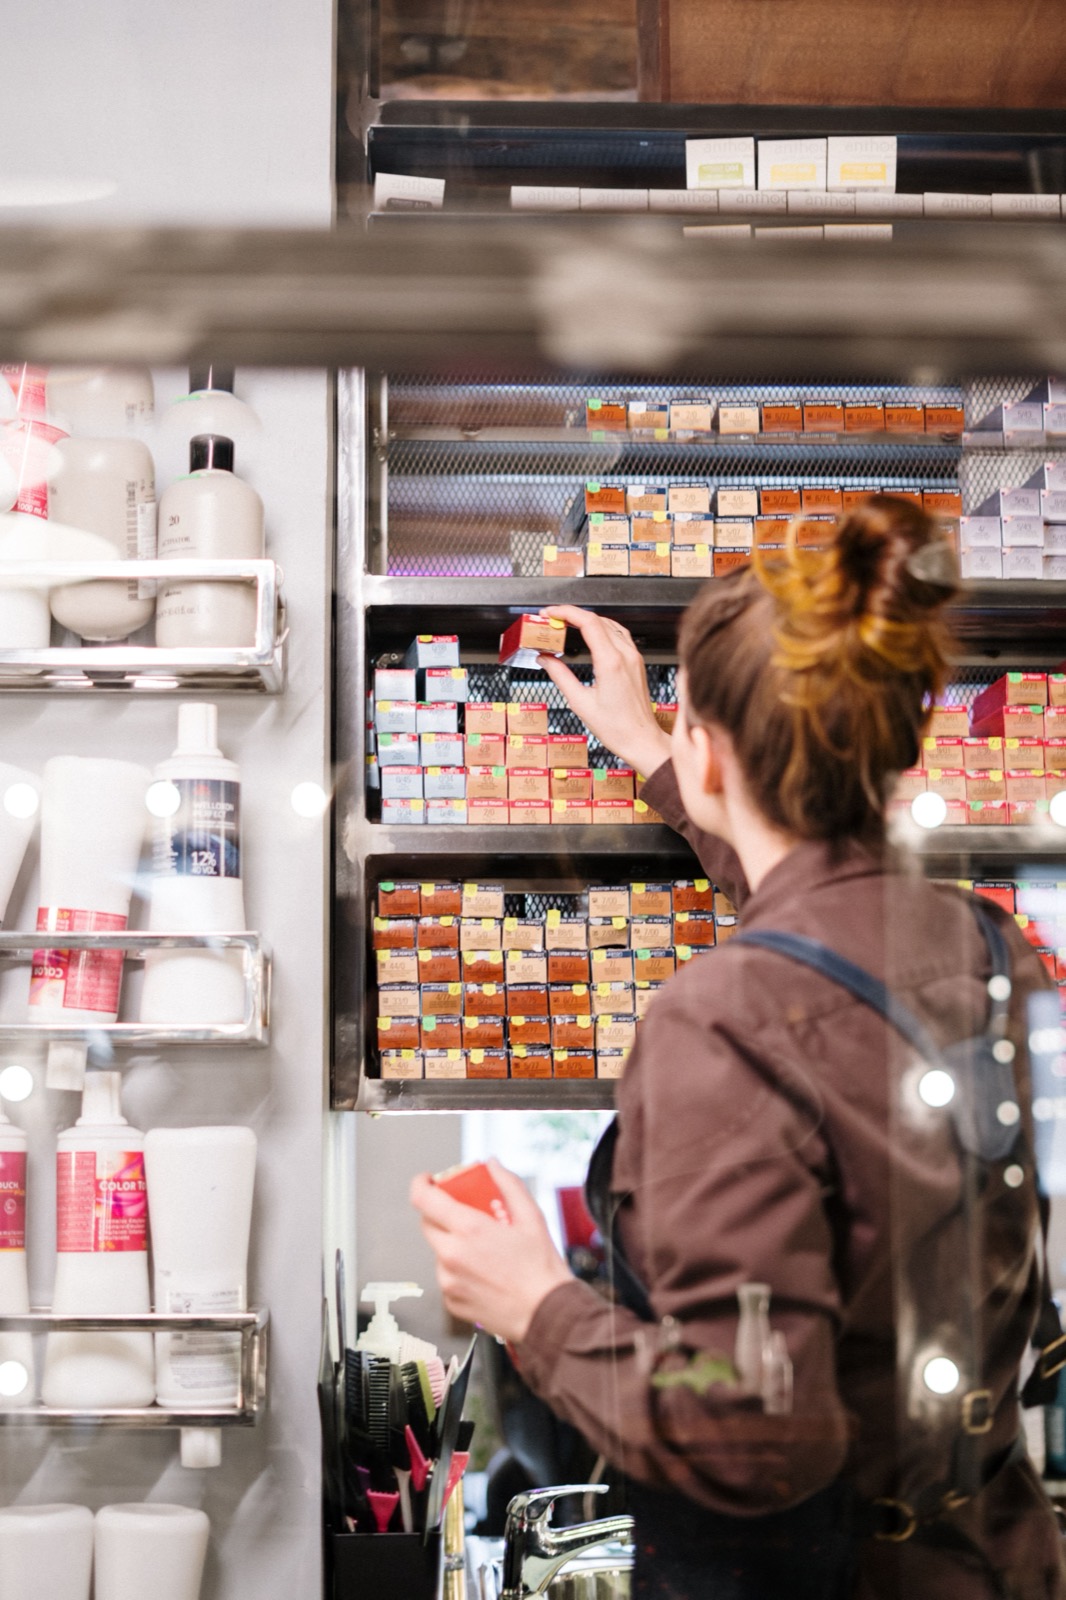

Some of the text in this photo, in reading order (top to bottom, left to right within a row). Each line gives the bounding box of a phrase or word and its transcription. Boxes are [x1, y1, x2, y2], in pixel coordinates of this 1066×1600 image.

[169, 515, 180, 527] 20
[191, 851, 217, 866] 12%
[99, 1180, 136, 1191] COLOR
